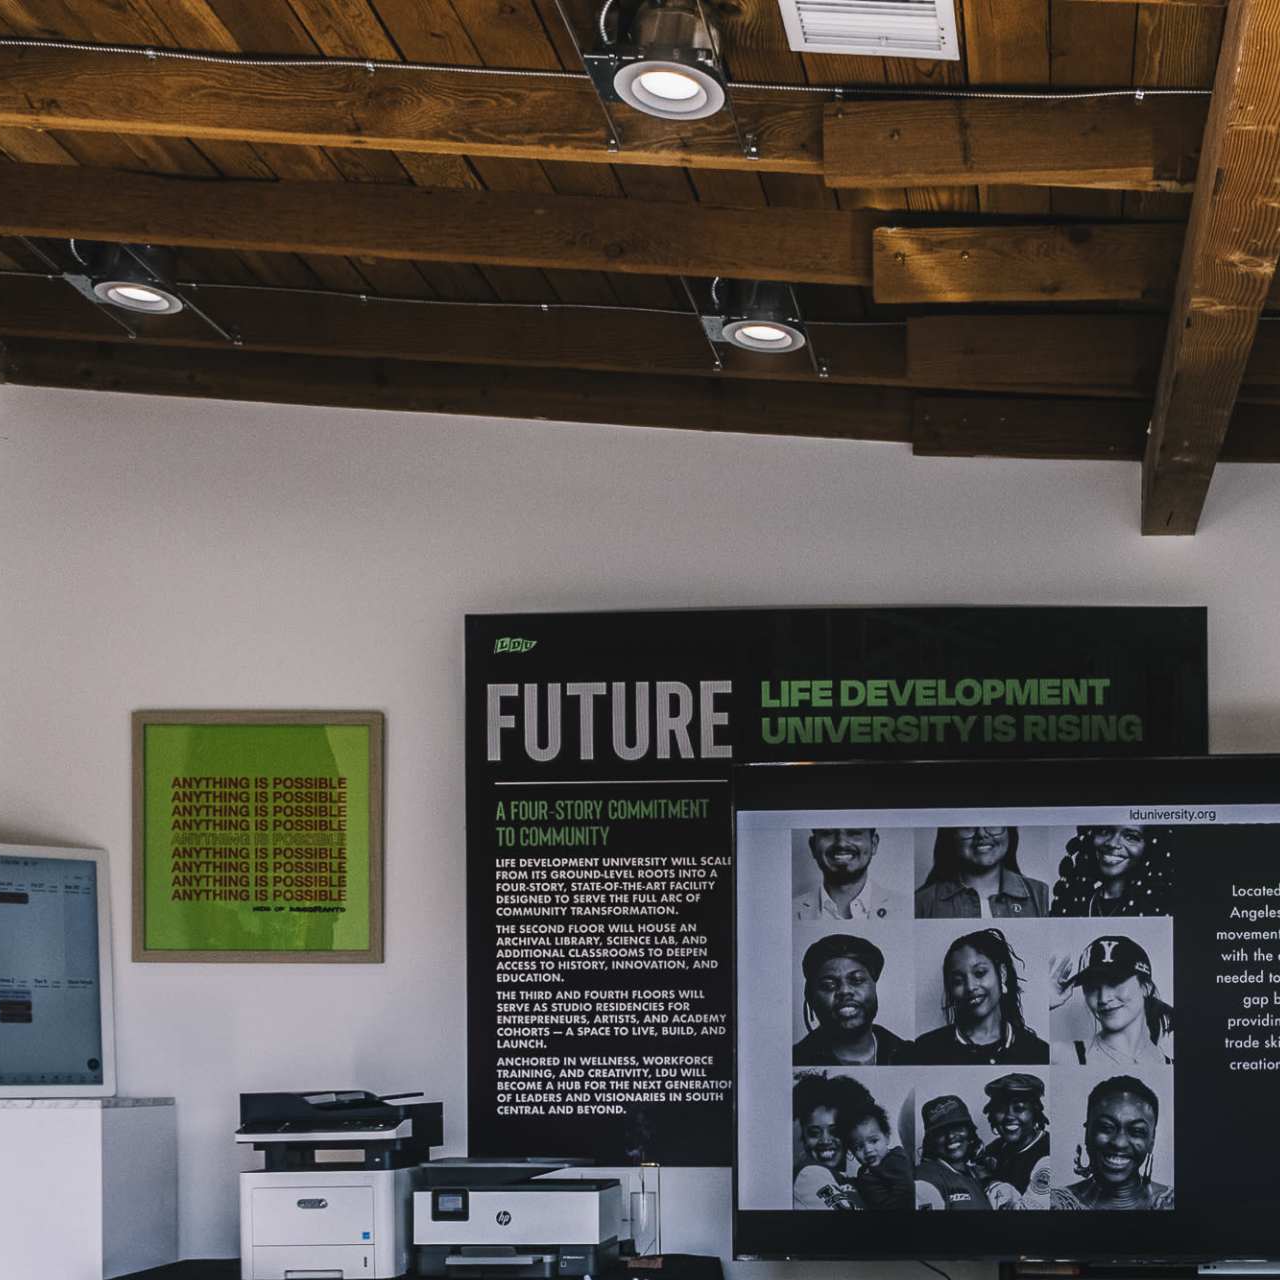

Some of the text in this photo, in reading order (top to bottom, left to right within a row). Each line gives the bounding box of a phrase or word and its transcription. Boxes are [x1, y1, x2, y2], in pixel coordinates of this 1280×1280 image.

[760, 678, 1110, 708] LIFE DEVELOPMENT
[486, 679, 733, 762] FUTURE
[760, 714, 1142, 744] UNIVERSITY IS RISING
[172, 776, 347, 789] ANYTHING IS POSSIBLE
[171, 790, 347, 803] ANYTHING IS POSSIBLE
[171, 804, 347, 817] ANYTHING IS POSSIBLE
[495, 799, 709, 821] A FOUR-STORY COMMITMENT
[1129, 808, 1216, 822] lduniversity.org
[171, 818, 347, 831] ANYTHING IS POSSIBLE
[495, 825, 610, 847] TO COMMUNITY
[171, 846, 347, 860] ANYTHING IS POSSIBLE
[171, 860, 347, 874] ANYTHING IS POSSIBLE
[495, 868, 717, 880] FROM ITS GROUND-LEVEL ROOTS INTO A
[171, 874, 347, 888] ANYTHING IS POSSIBLE
[496, 881, 715, 892] FOUR-STORY, STATE-OF-THE-ART FACILITY
[171, 888, 347, 902] ANYTHING IS POSSIBLE
[495, 905, 678, 916] COMMUNITY TRANSFORMATION.
[495, 923, 696, 934] THE SECOND FLOOR WILL HOUSE AN
[496, 935, 707, 946] ARCHIVAL LIBRARY, SCIENCE LAB, AND
[496, 947, 707, 958] ADDITIONAL CLASSROOMS TO DEEPEN
[1099, 940, 1119, 963] Y
[1220, 947, 1248, 961] with
[1253, 947, 1273, 962] the
[496, 959, 718, 971] ACCESS TO HISTORY, INNOVATION, AND
[496, 972, 564, 983] EDUCATION.
[1216, 969, 1264, 984] needed
[1268, 972, 1280, 983] to
[1242, 996, 1269, 1008] gap
[1224, 1034, 1260, 1048] trade
[496, 1055, 713, 1066] ANCHORED IN WELLNESS, WORKFORCE
[496, 1068, 706, 1079] TRAINING, AND CREATIVITY, LDU WILL
[496, 1092, 723, 1103] OF LEADERS AND VISIONARIES IN SOUTH
[496, 1104, 626, 1115] CENTRAL AND BEYOND.
